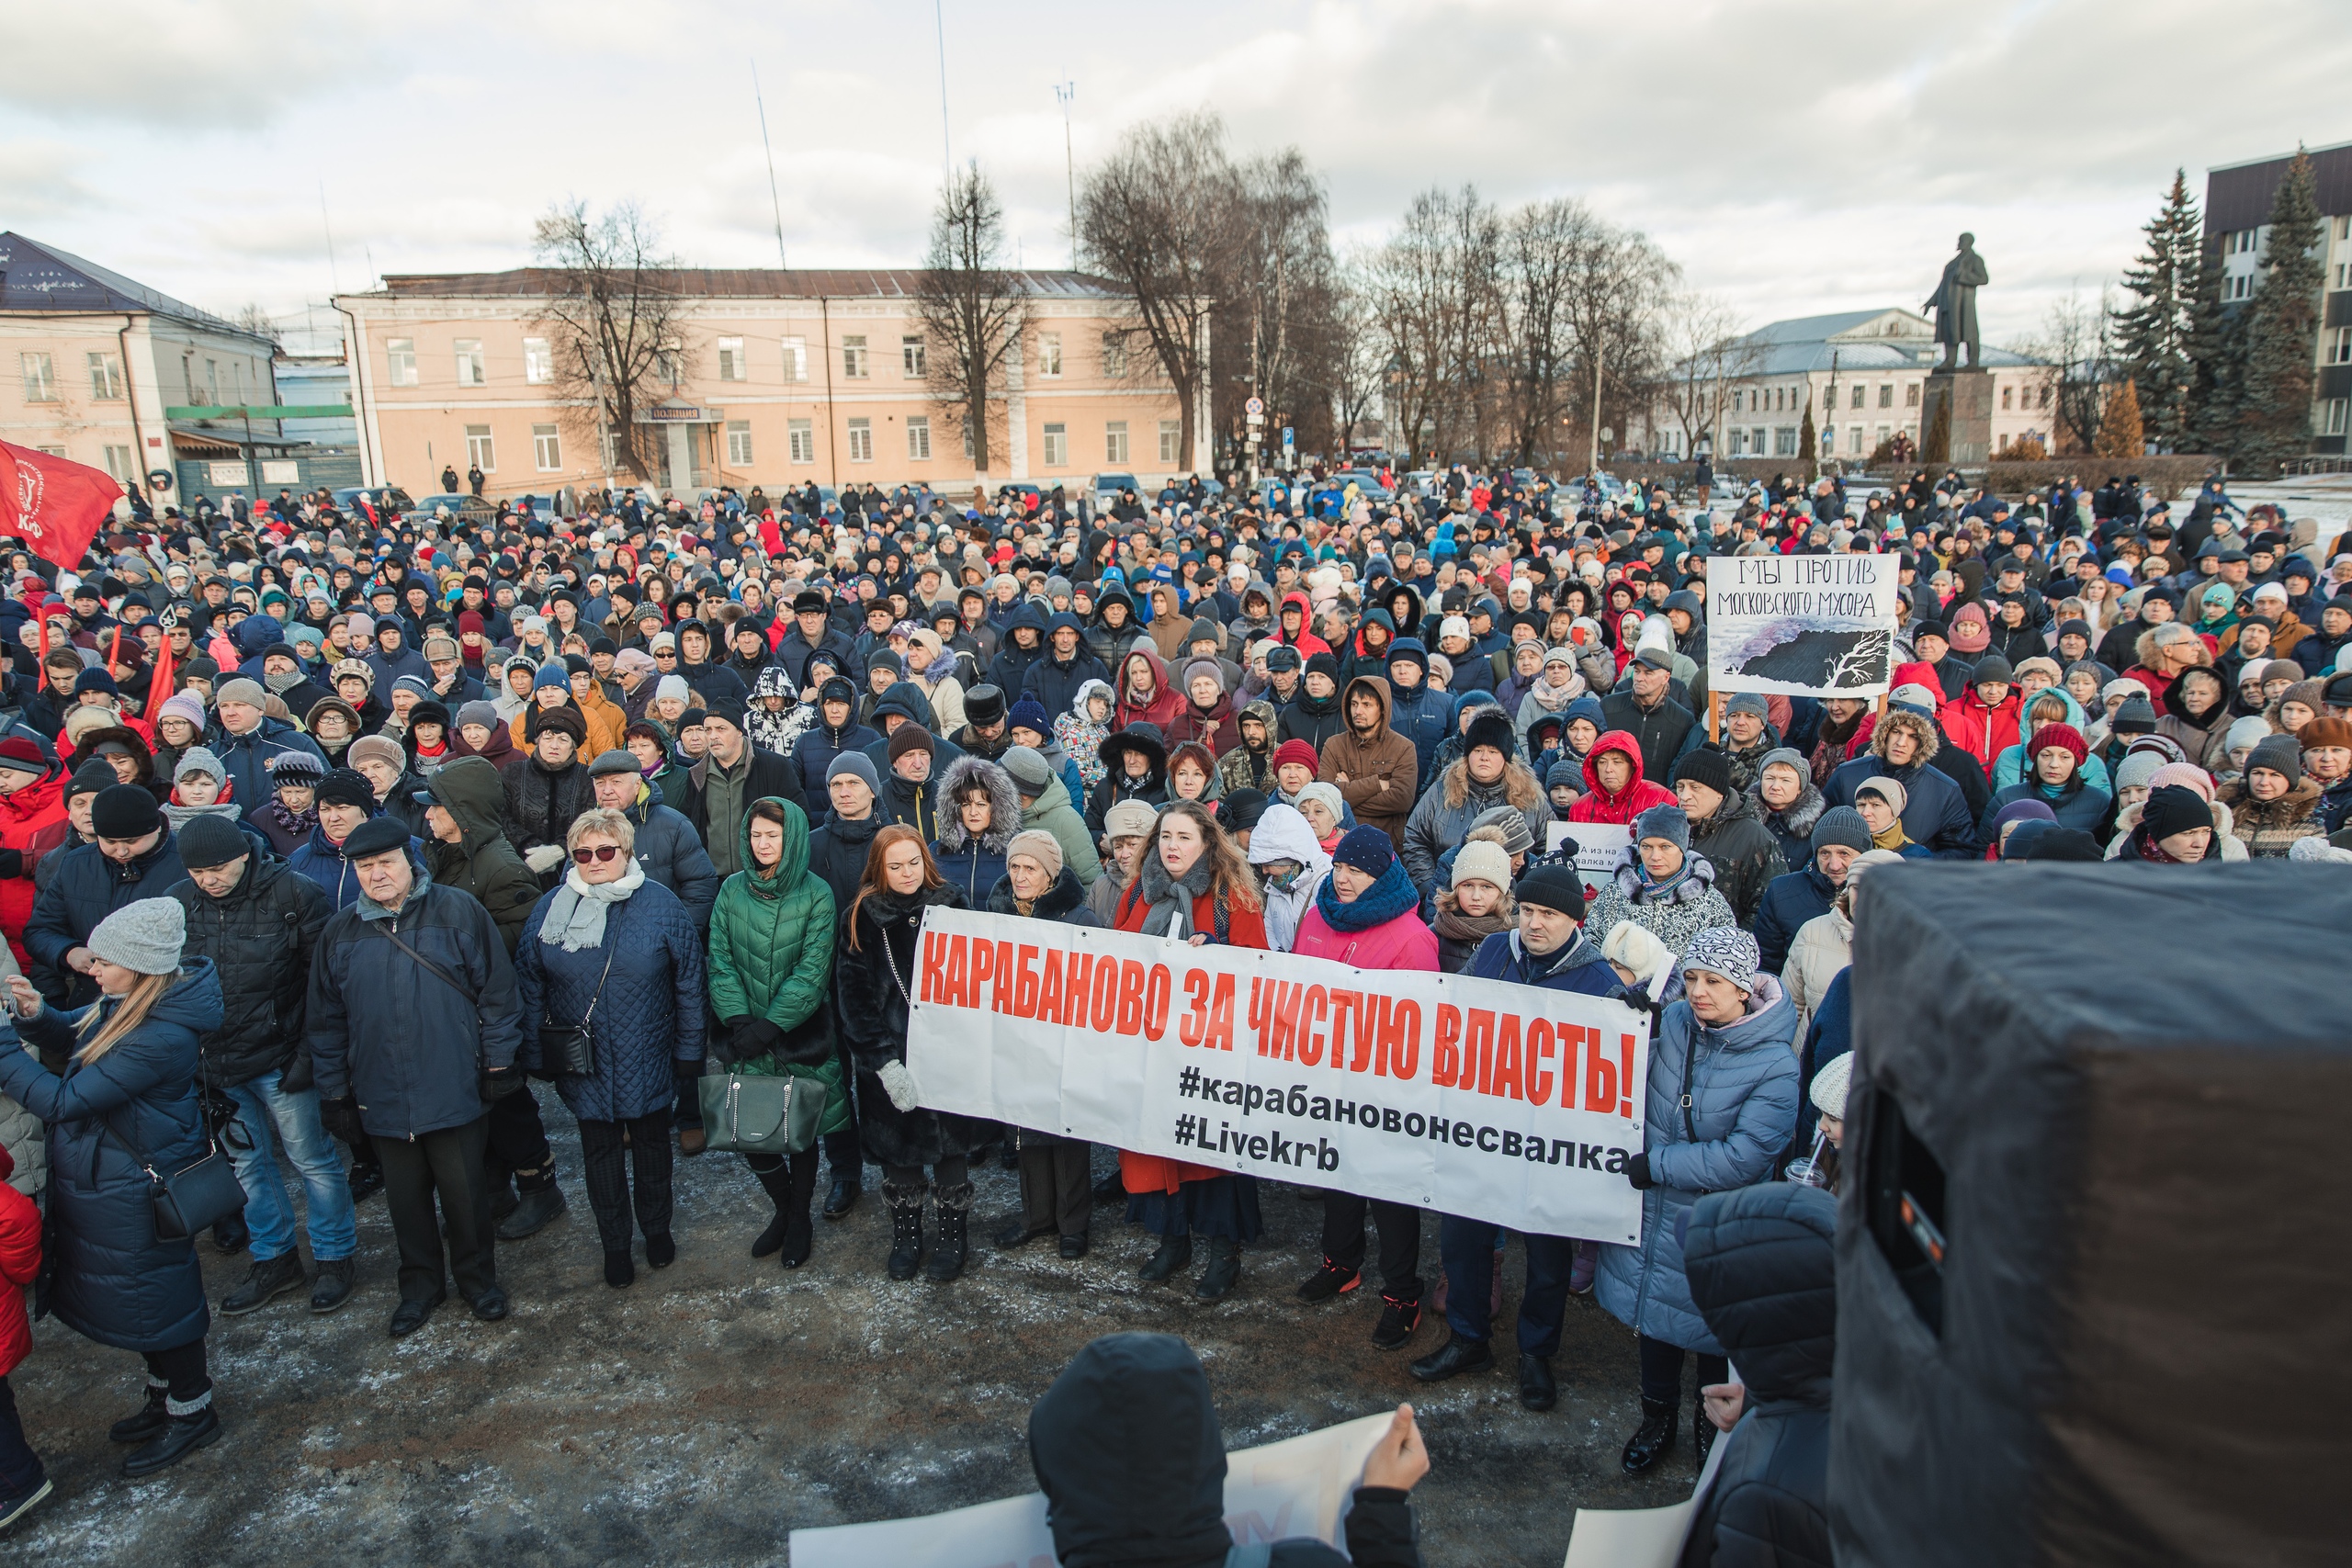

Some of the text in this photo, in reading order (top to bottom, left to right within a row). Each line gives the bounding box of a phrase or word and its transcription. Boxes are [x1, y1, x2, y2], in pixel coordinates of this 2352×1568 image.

[653, 409, 697, 418] ПОЛИЦИЯ
[1738, 558, 1877, 585] МЫ ПРОТИВ
[1717, 592, 1877, 617] МОСКОВСКОГО МУСОРА
[920, 931, 1635, 1119] КАРАБАНОВО ЗА ЧИСТУЮ ВЛАСТЬ!
[1174, 1112, 1340, 1172] #Livekrb
[1179, 1066, 1630, 1175] #карабановонесвалка
